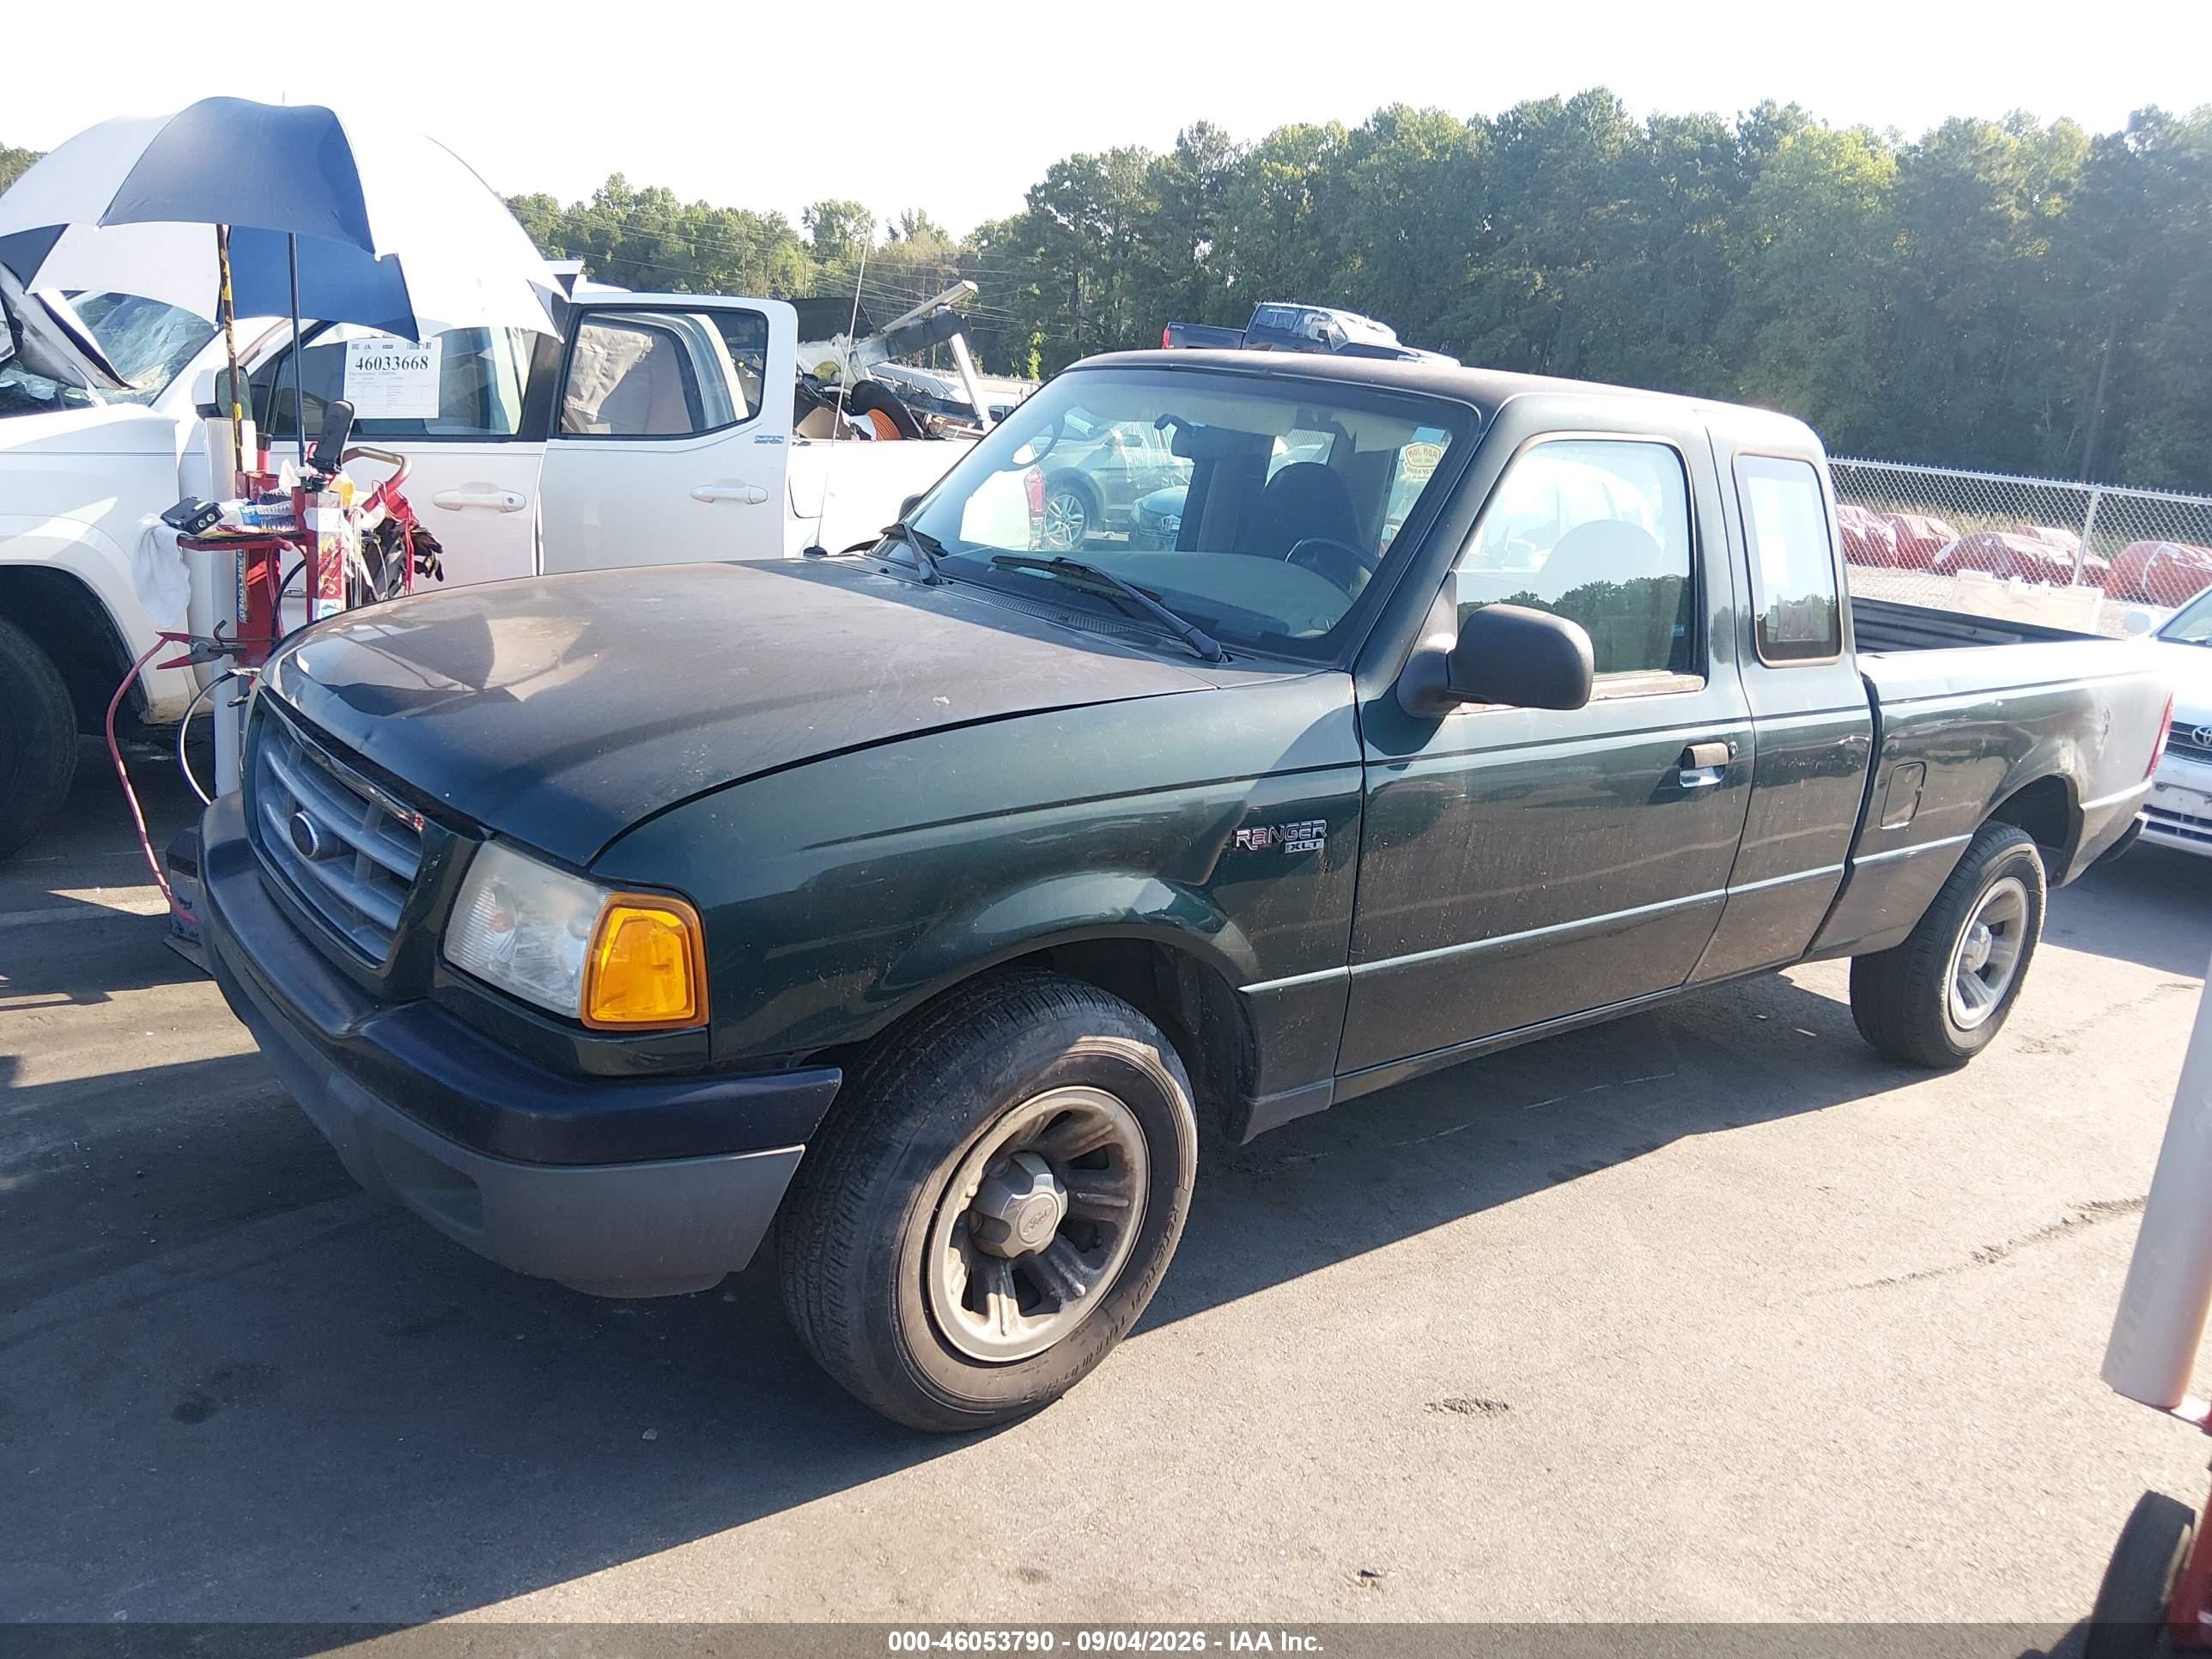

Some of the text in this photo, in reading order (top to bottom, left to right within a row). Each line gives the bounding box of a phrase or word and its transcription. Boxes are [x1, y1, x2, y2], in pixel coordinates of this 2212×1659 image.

[355, 356, 428, 371] 46033668
[1235, 819, 1328, 851] RANGER
[1291, 840, 1322, 852] XLT
